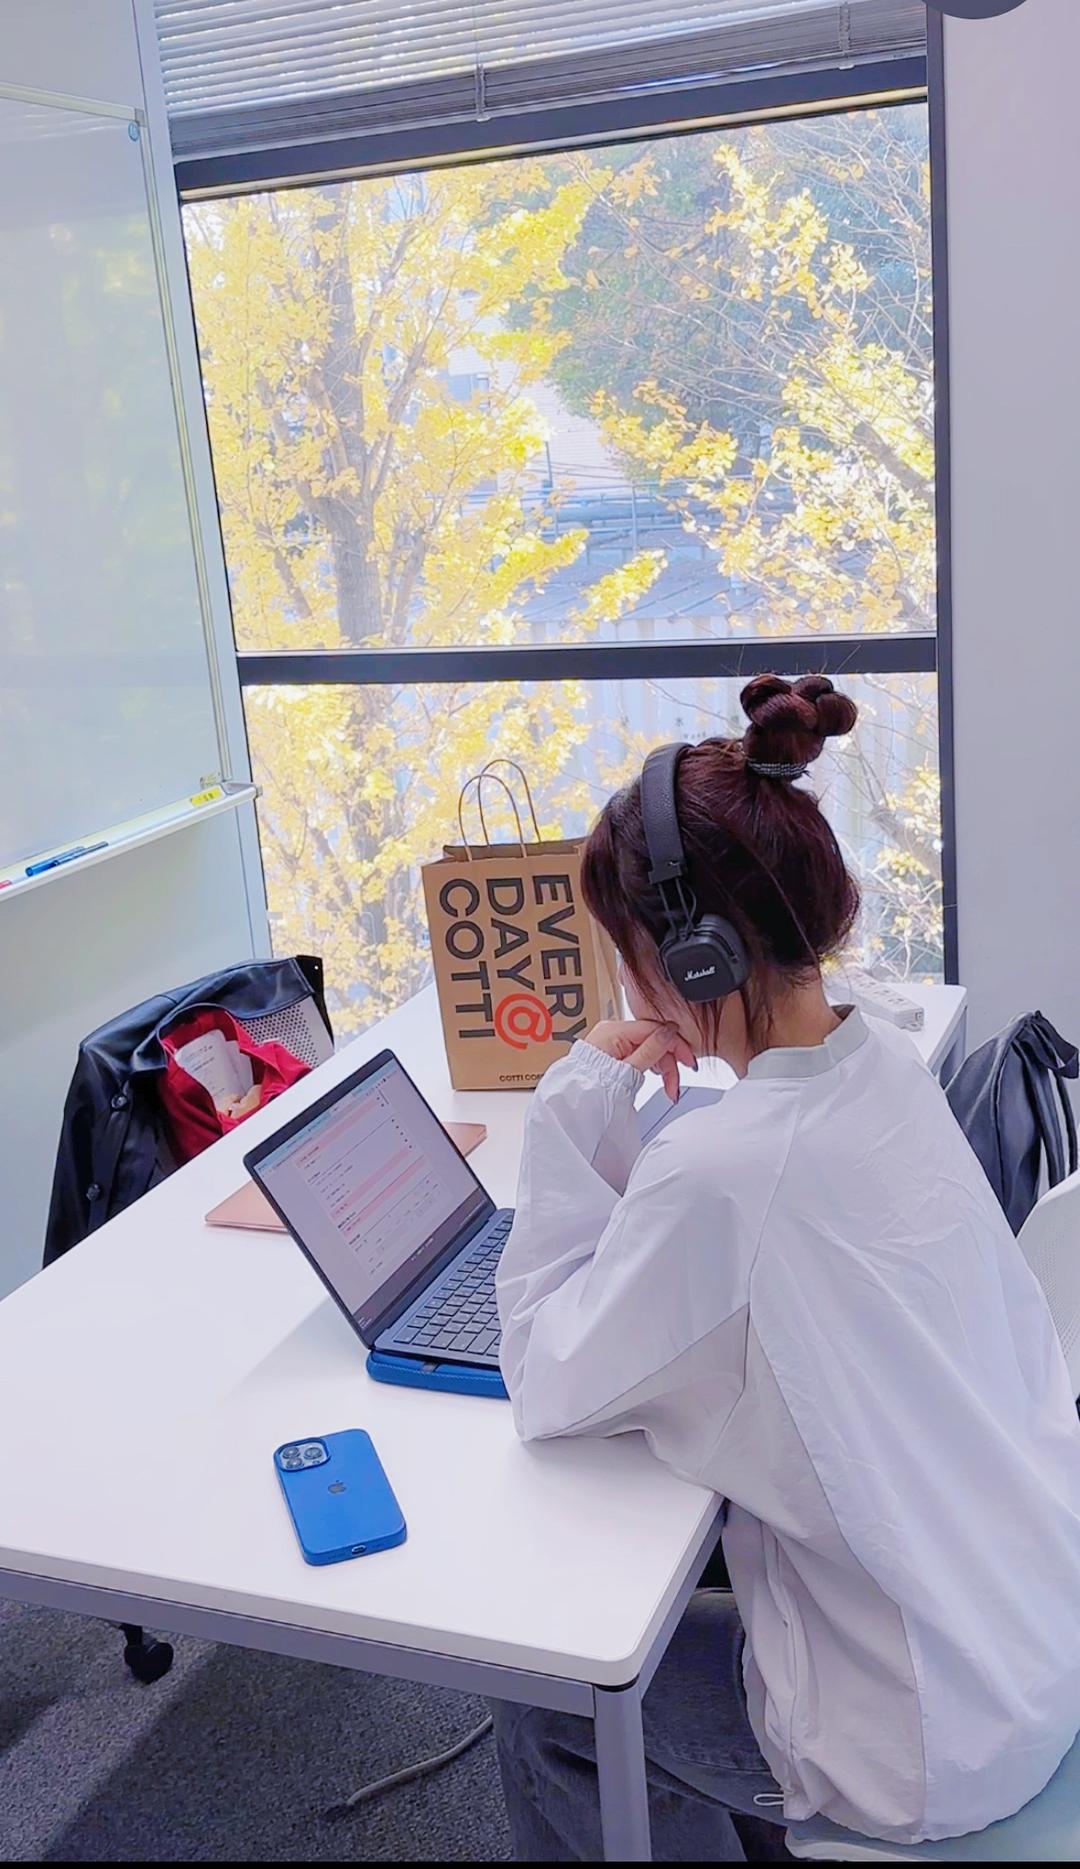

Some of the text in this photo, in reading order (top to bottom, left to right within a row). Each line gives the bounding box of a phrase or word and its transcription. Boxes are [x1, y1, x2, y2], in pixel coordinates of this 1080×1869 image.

[439, 878, 495, 1038] COTTI
[532, 874, 588, 1043] EVERY
[499, 1074, 523, 1082] COTTI
